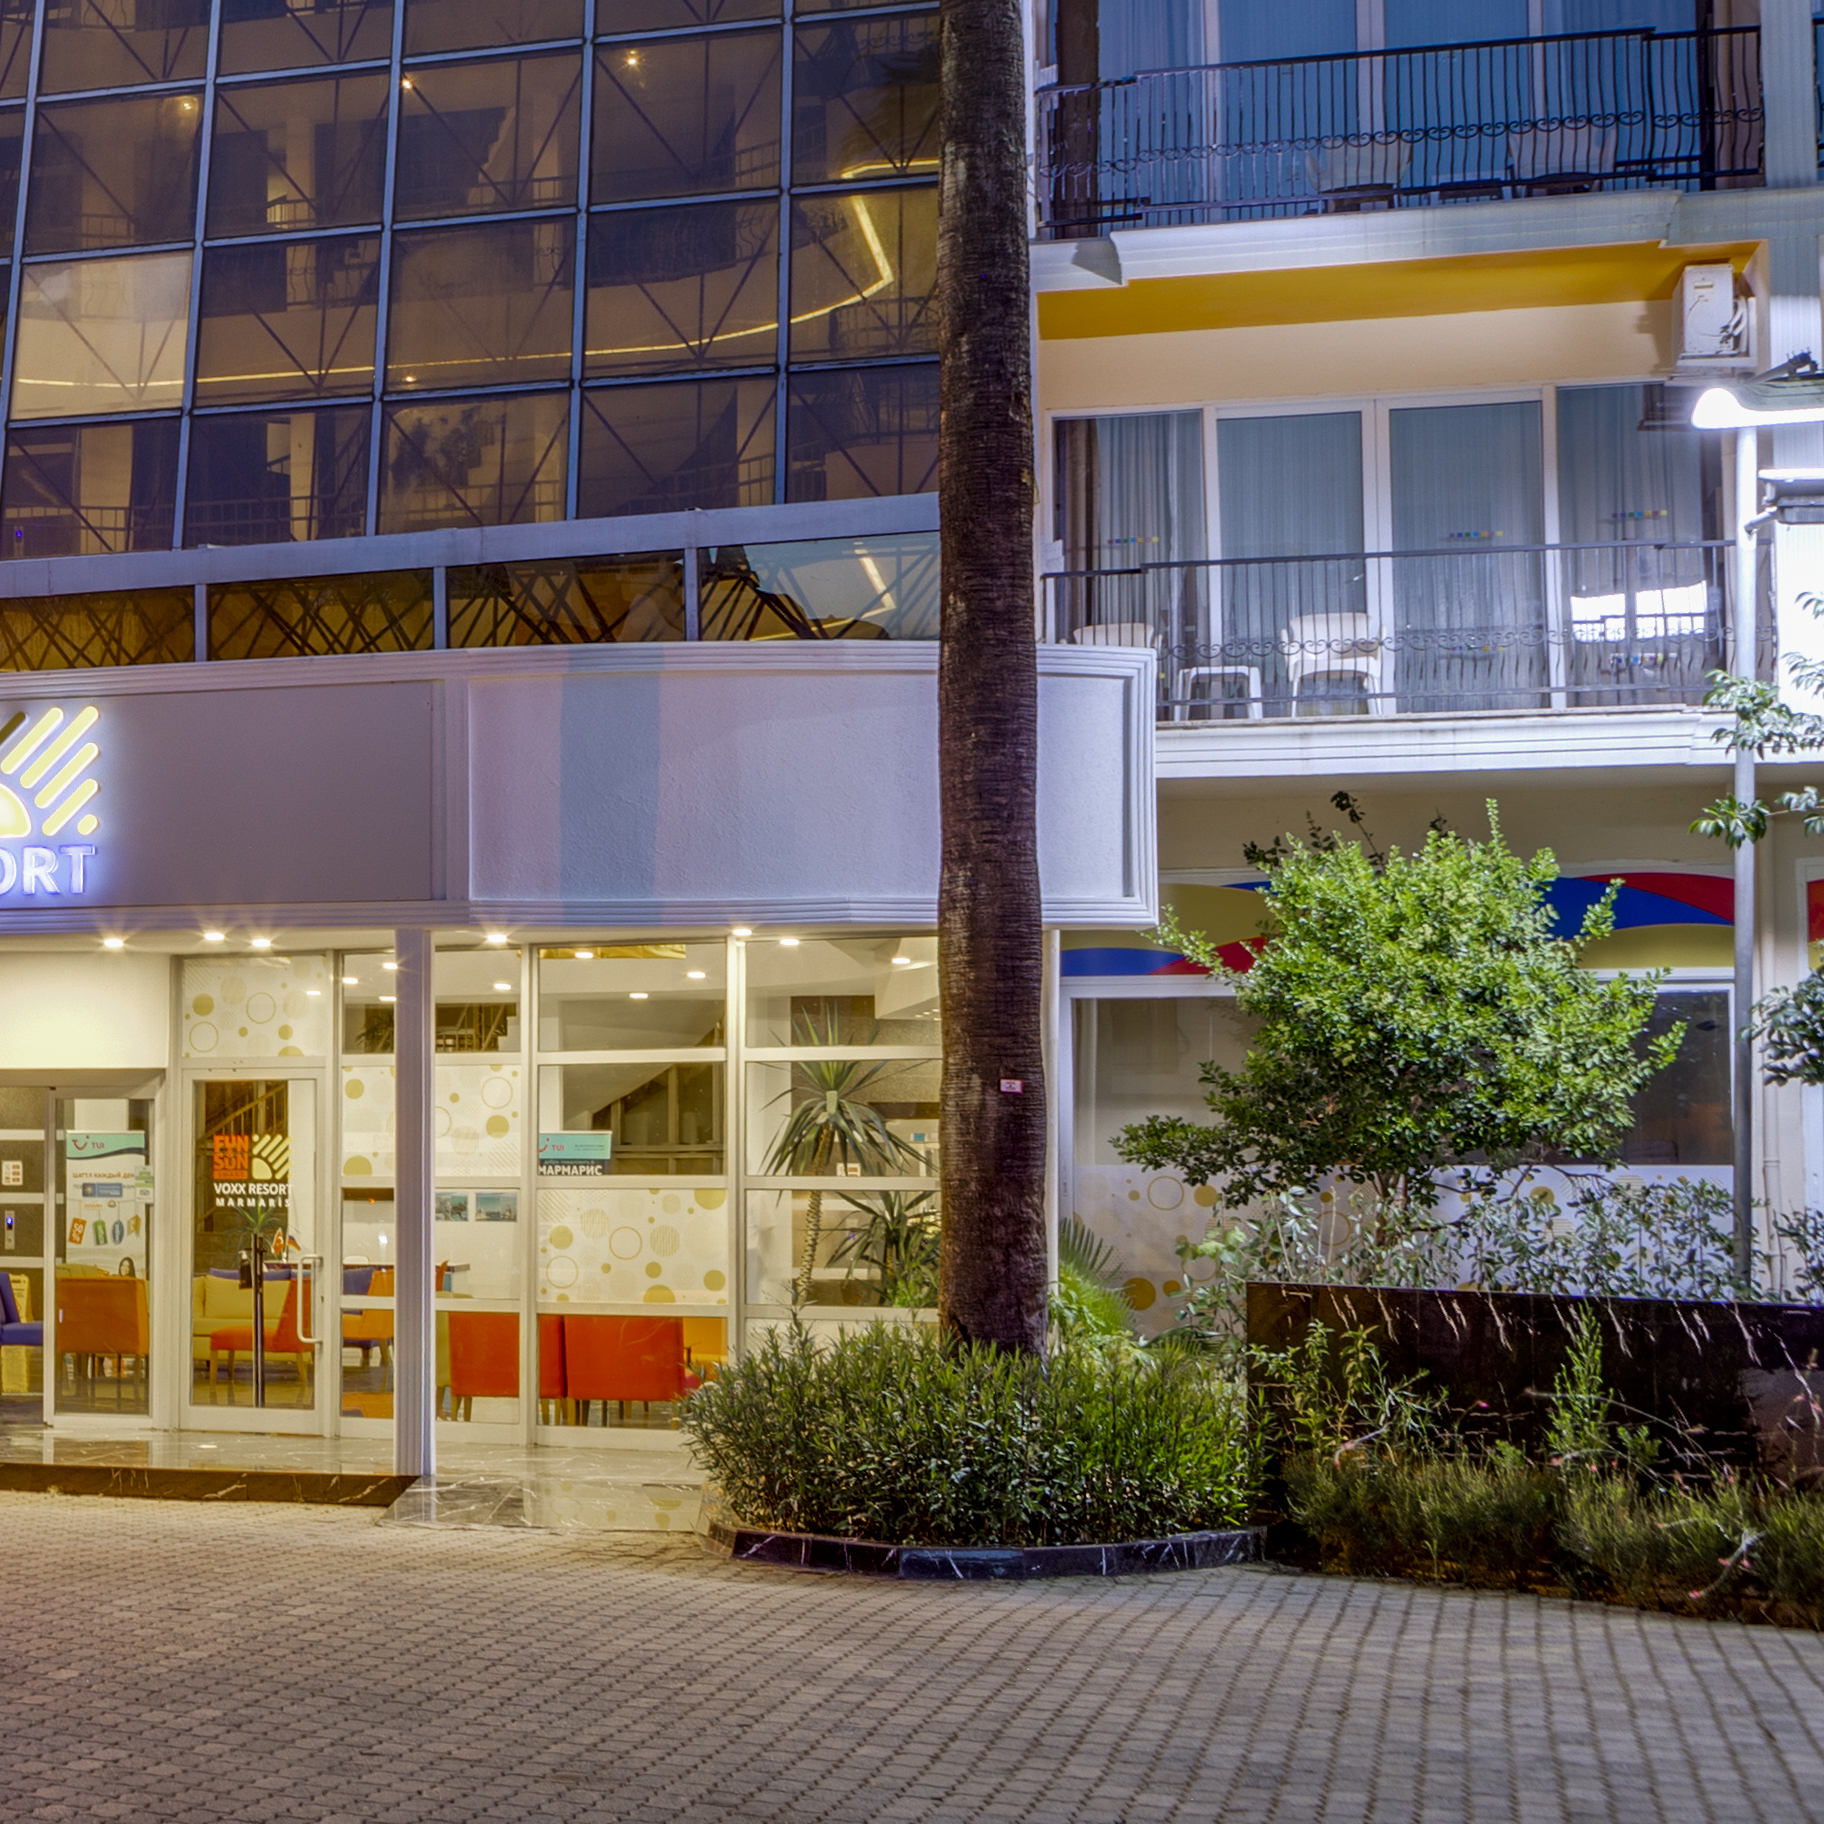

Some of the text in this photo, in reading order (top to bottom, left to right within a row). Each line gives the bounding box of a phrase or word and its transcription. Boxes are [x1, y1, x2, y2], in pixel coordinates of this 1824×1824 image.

[92, 1141, 105, 1149] TUI
[213, 1134, 250, 1152] FUN
[213, 1152, 249, 1169] SUN
[538, 1164, 603, 1175] МАРМАРИС
[213, 1182, 293, 1195] VOXX RESORT
